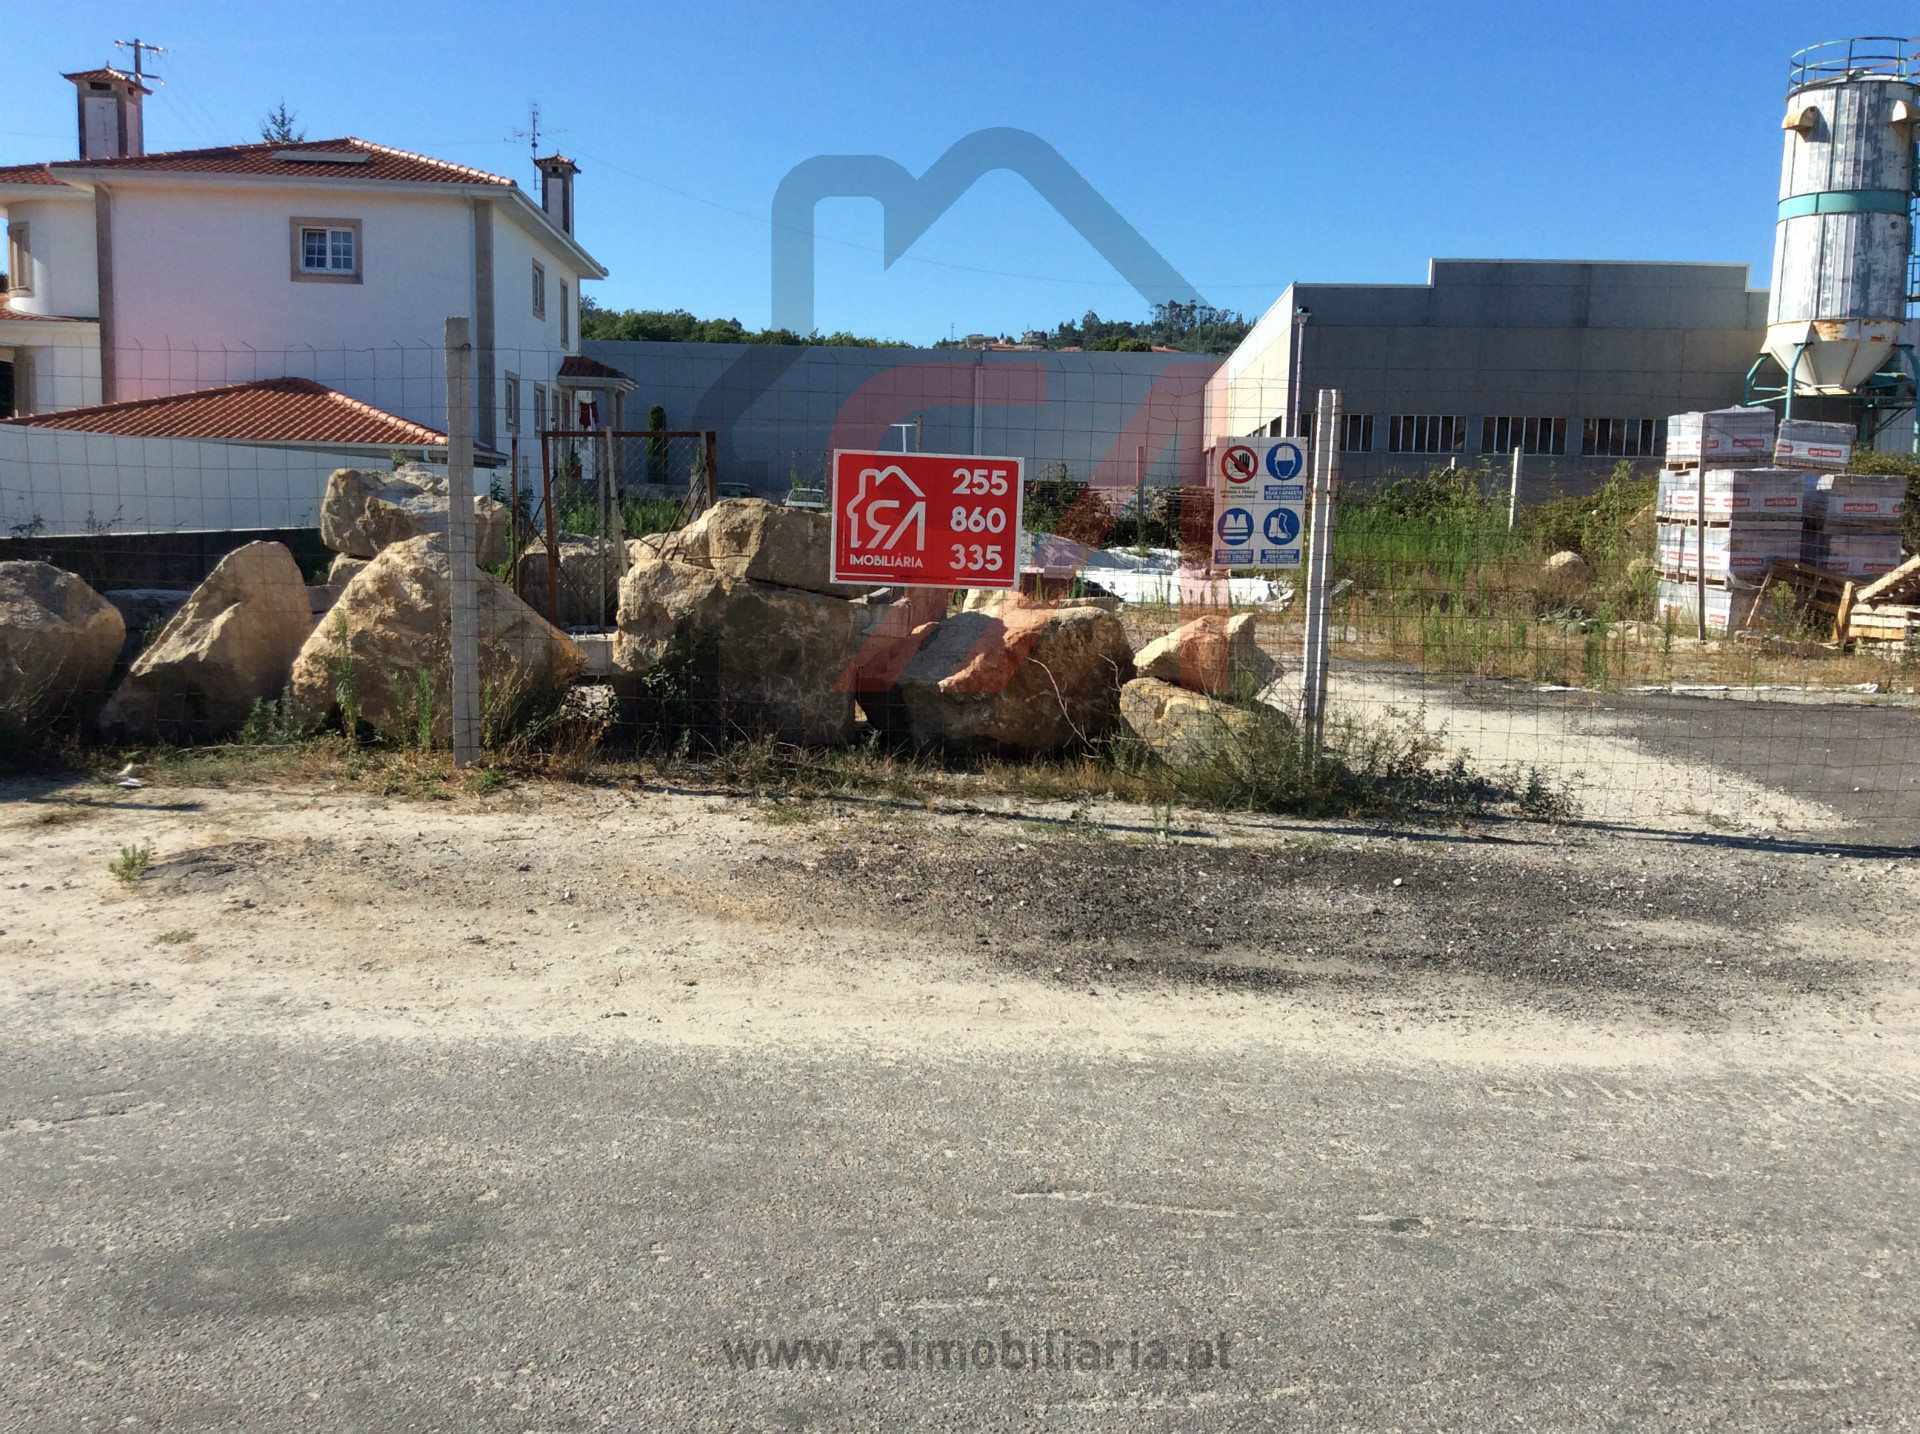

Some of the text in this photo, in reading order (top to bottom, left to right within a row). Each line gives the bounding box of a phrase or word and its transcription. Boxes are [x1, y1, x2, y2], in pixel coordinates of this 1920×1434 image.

[952, 468, 1009, 496] 255
[950, 506, 1007, 534] 860
[849, 552, 924, 568] IMOBILIÁRIA
[949, 543, 1003, 571] 335
